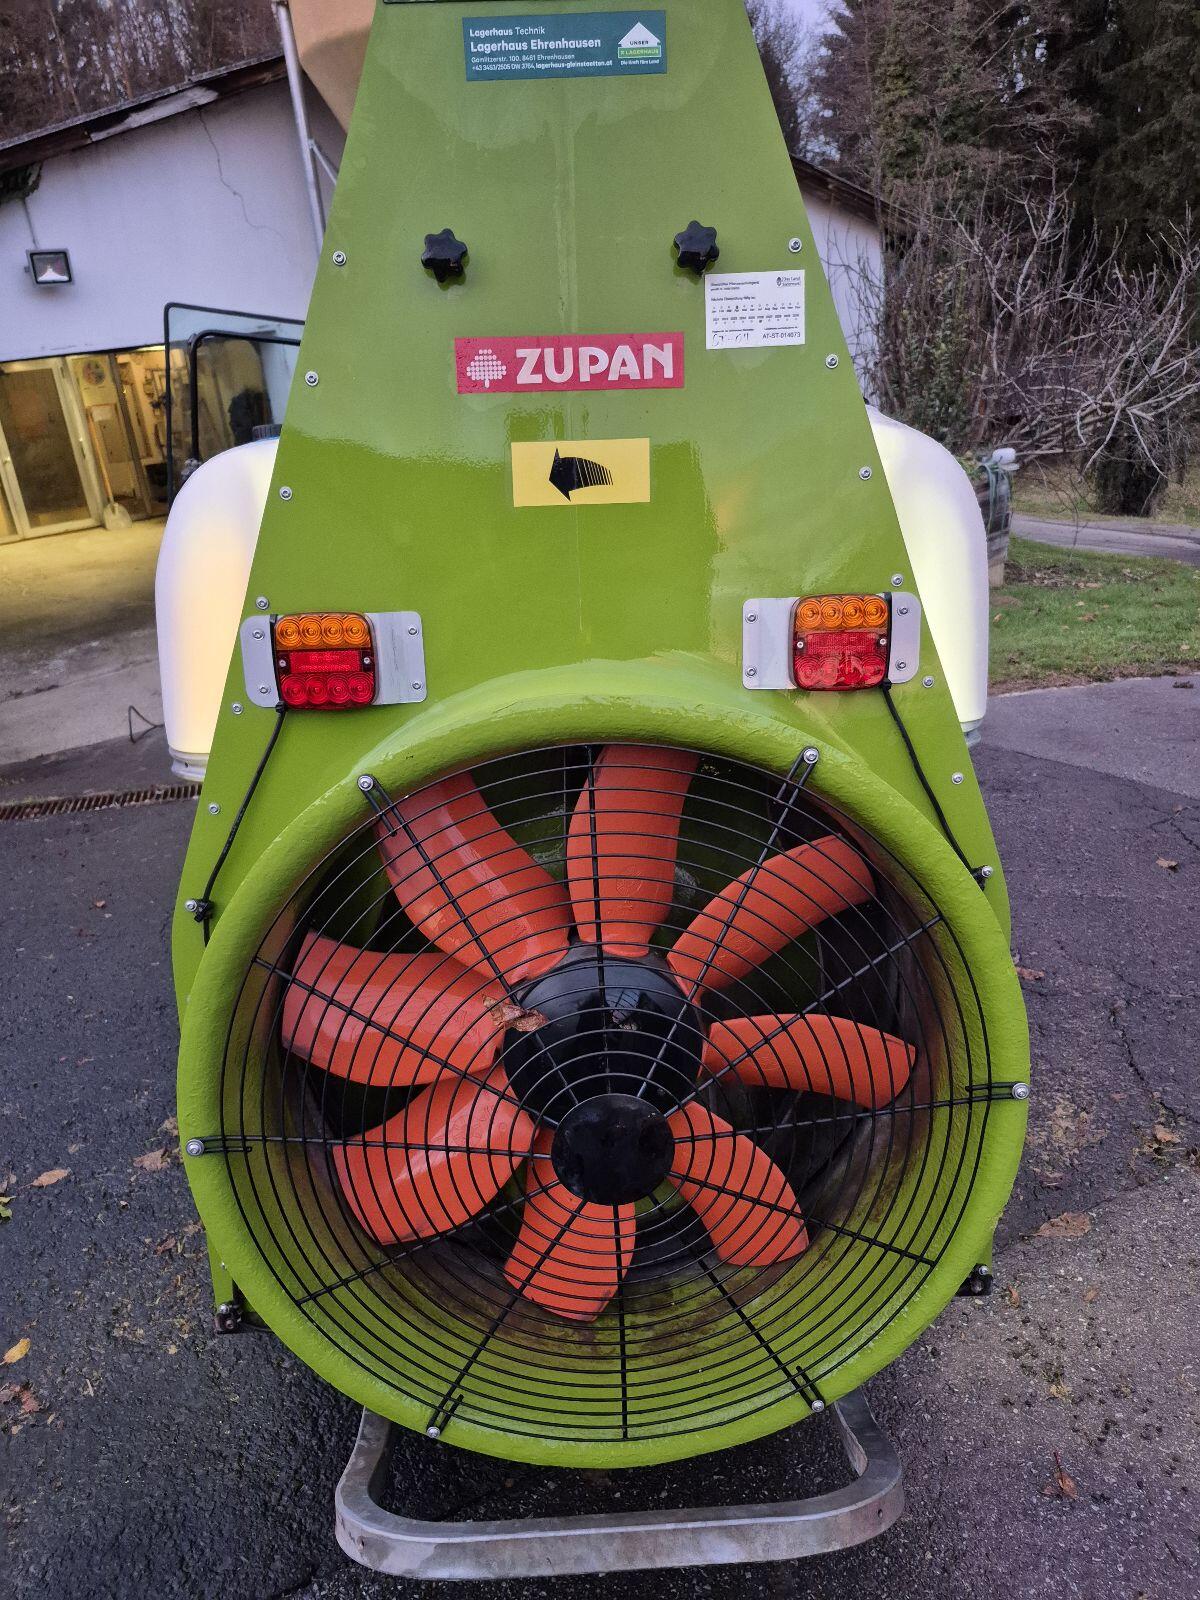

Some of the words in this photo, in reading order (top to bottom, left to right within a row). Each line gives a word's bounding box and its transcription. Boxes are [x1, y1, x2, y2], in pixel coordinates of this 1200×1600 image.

[470, 27, 513, 38] Lagerhaus
[515, 26, 546, 36] Technik
[470, 40, 528, 54] Lagerhaus
[530, 38, 601, 50] Ehrenhausen
[537, 53, 575, 61] Ehrenhausen
[516, 342, 674, 385] ZUPAN
